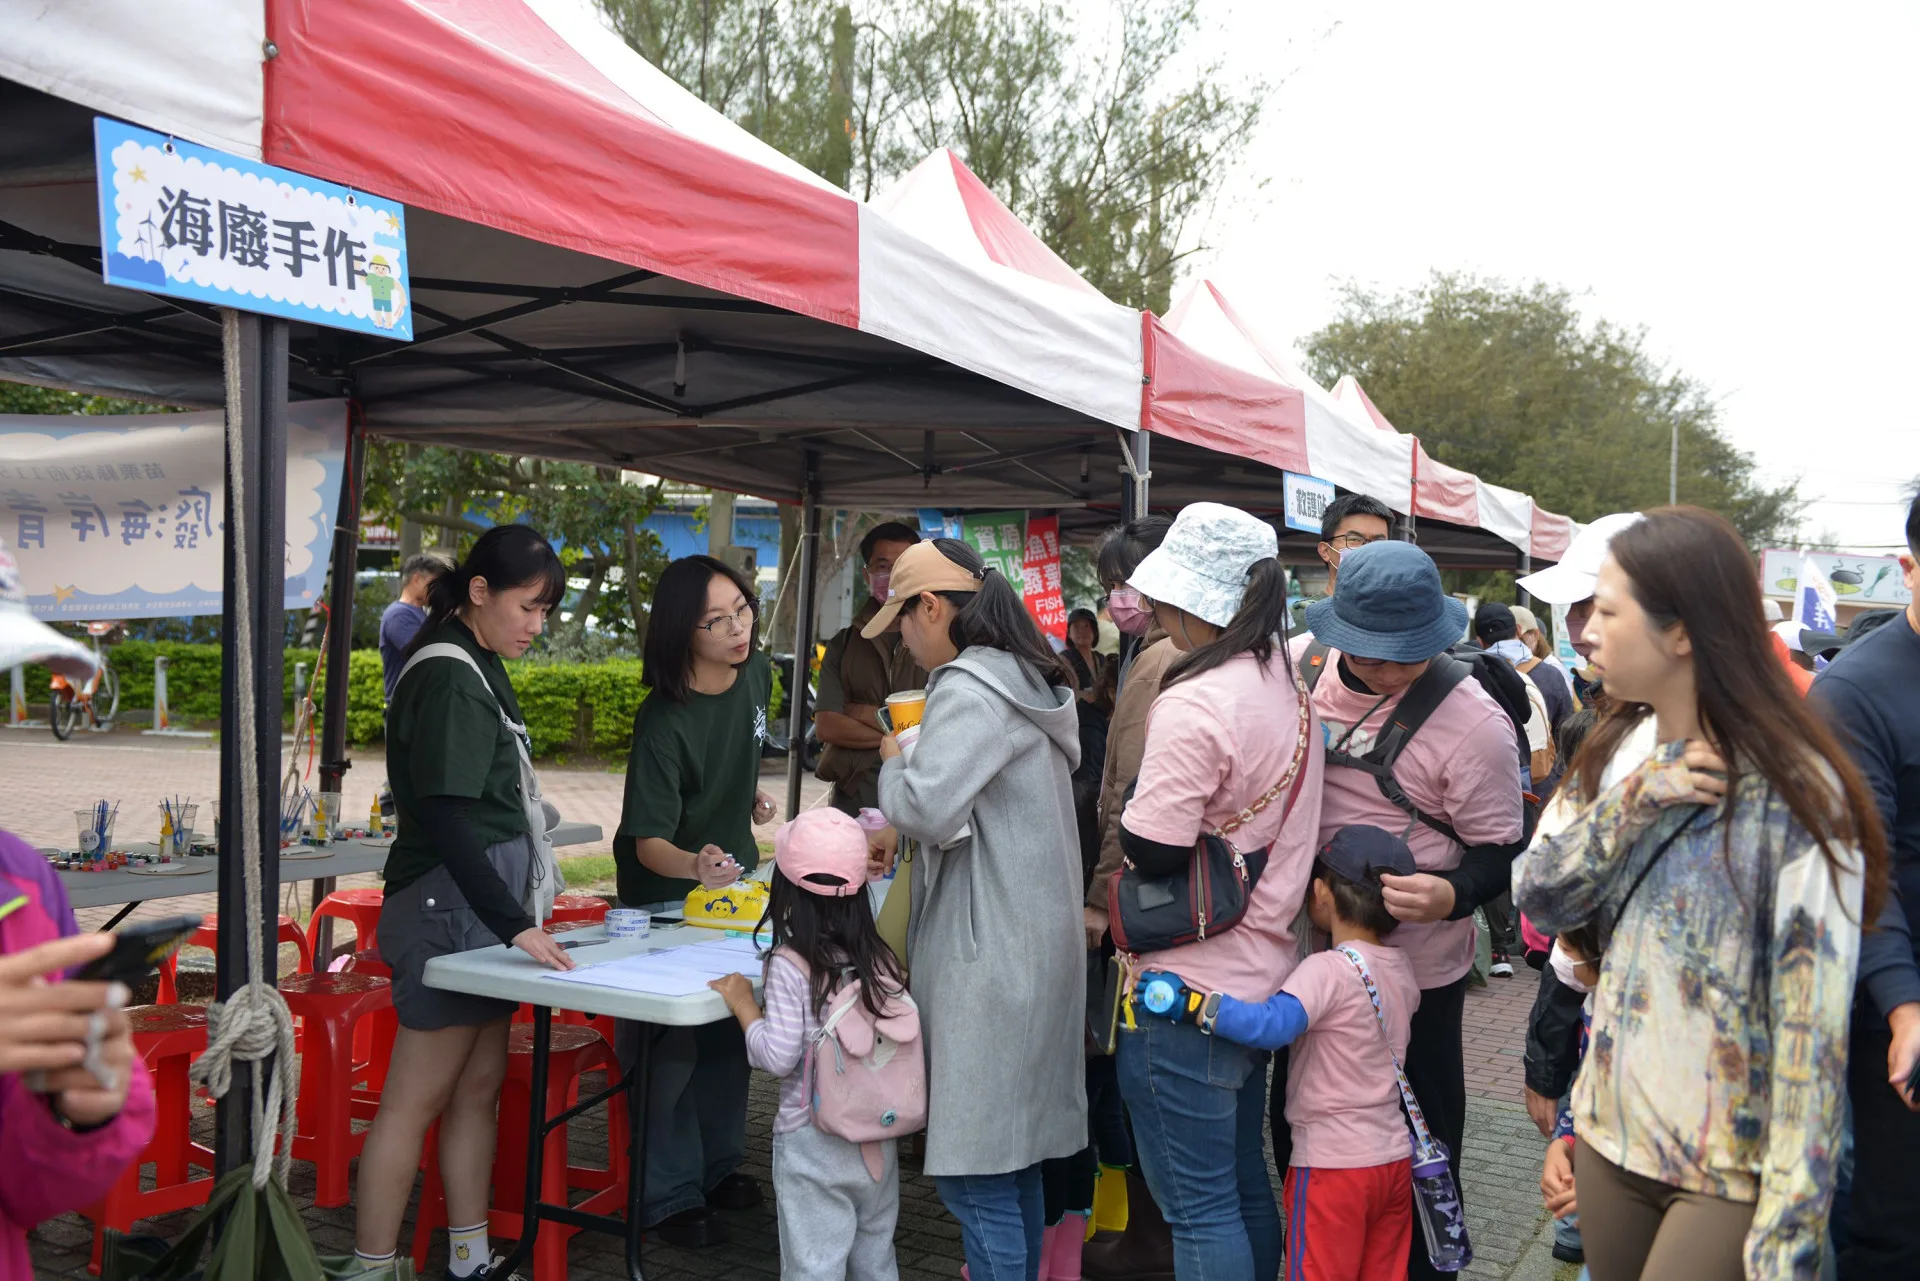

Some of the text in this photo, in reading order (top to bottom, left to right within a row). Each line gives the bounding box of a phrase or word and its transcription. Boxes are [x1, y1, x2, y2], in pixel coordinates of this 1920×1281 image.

[157, 185, 369, 291] 海廢手作
[973, 523, 1021, 553] 資源
[1024, 530, 1058, 563] 漁業
